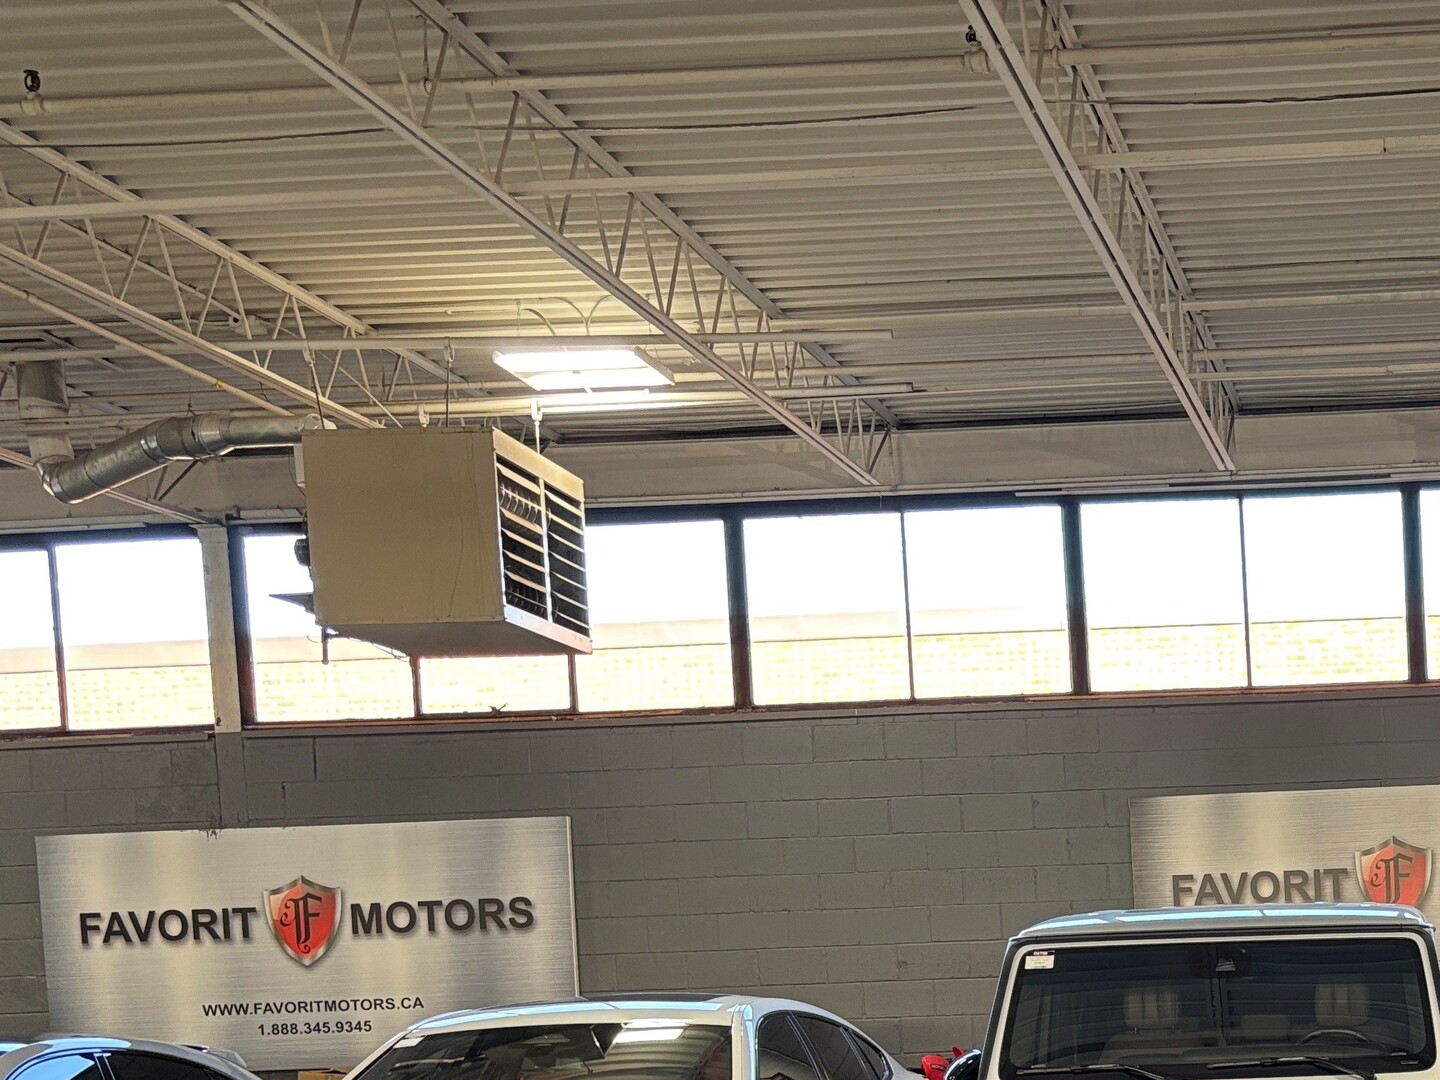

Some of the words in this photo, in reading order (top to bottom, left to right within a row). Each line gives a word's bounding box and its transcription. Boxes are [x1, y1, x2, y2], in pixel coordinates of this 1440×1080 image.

[1172, 867, 1348, 906] FAVORIT
[79, 906, 257, 944] FAVORIT
[350, 896, 535, 936] MOTORS
[202, 996, 425, 1018] WWW.FAVORITMOTORS.CA
[257, 1020, 373, 1037] 1.888.345.9345
